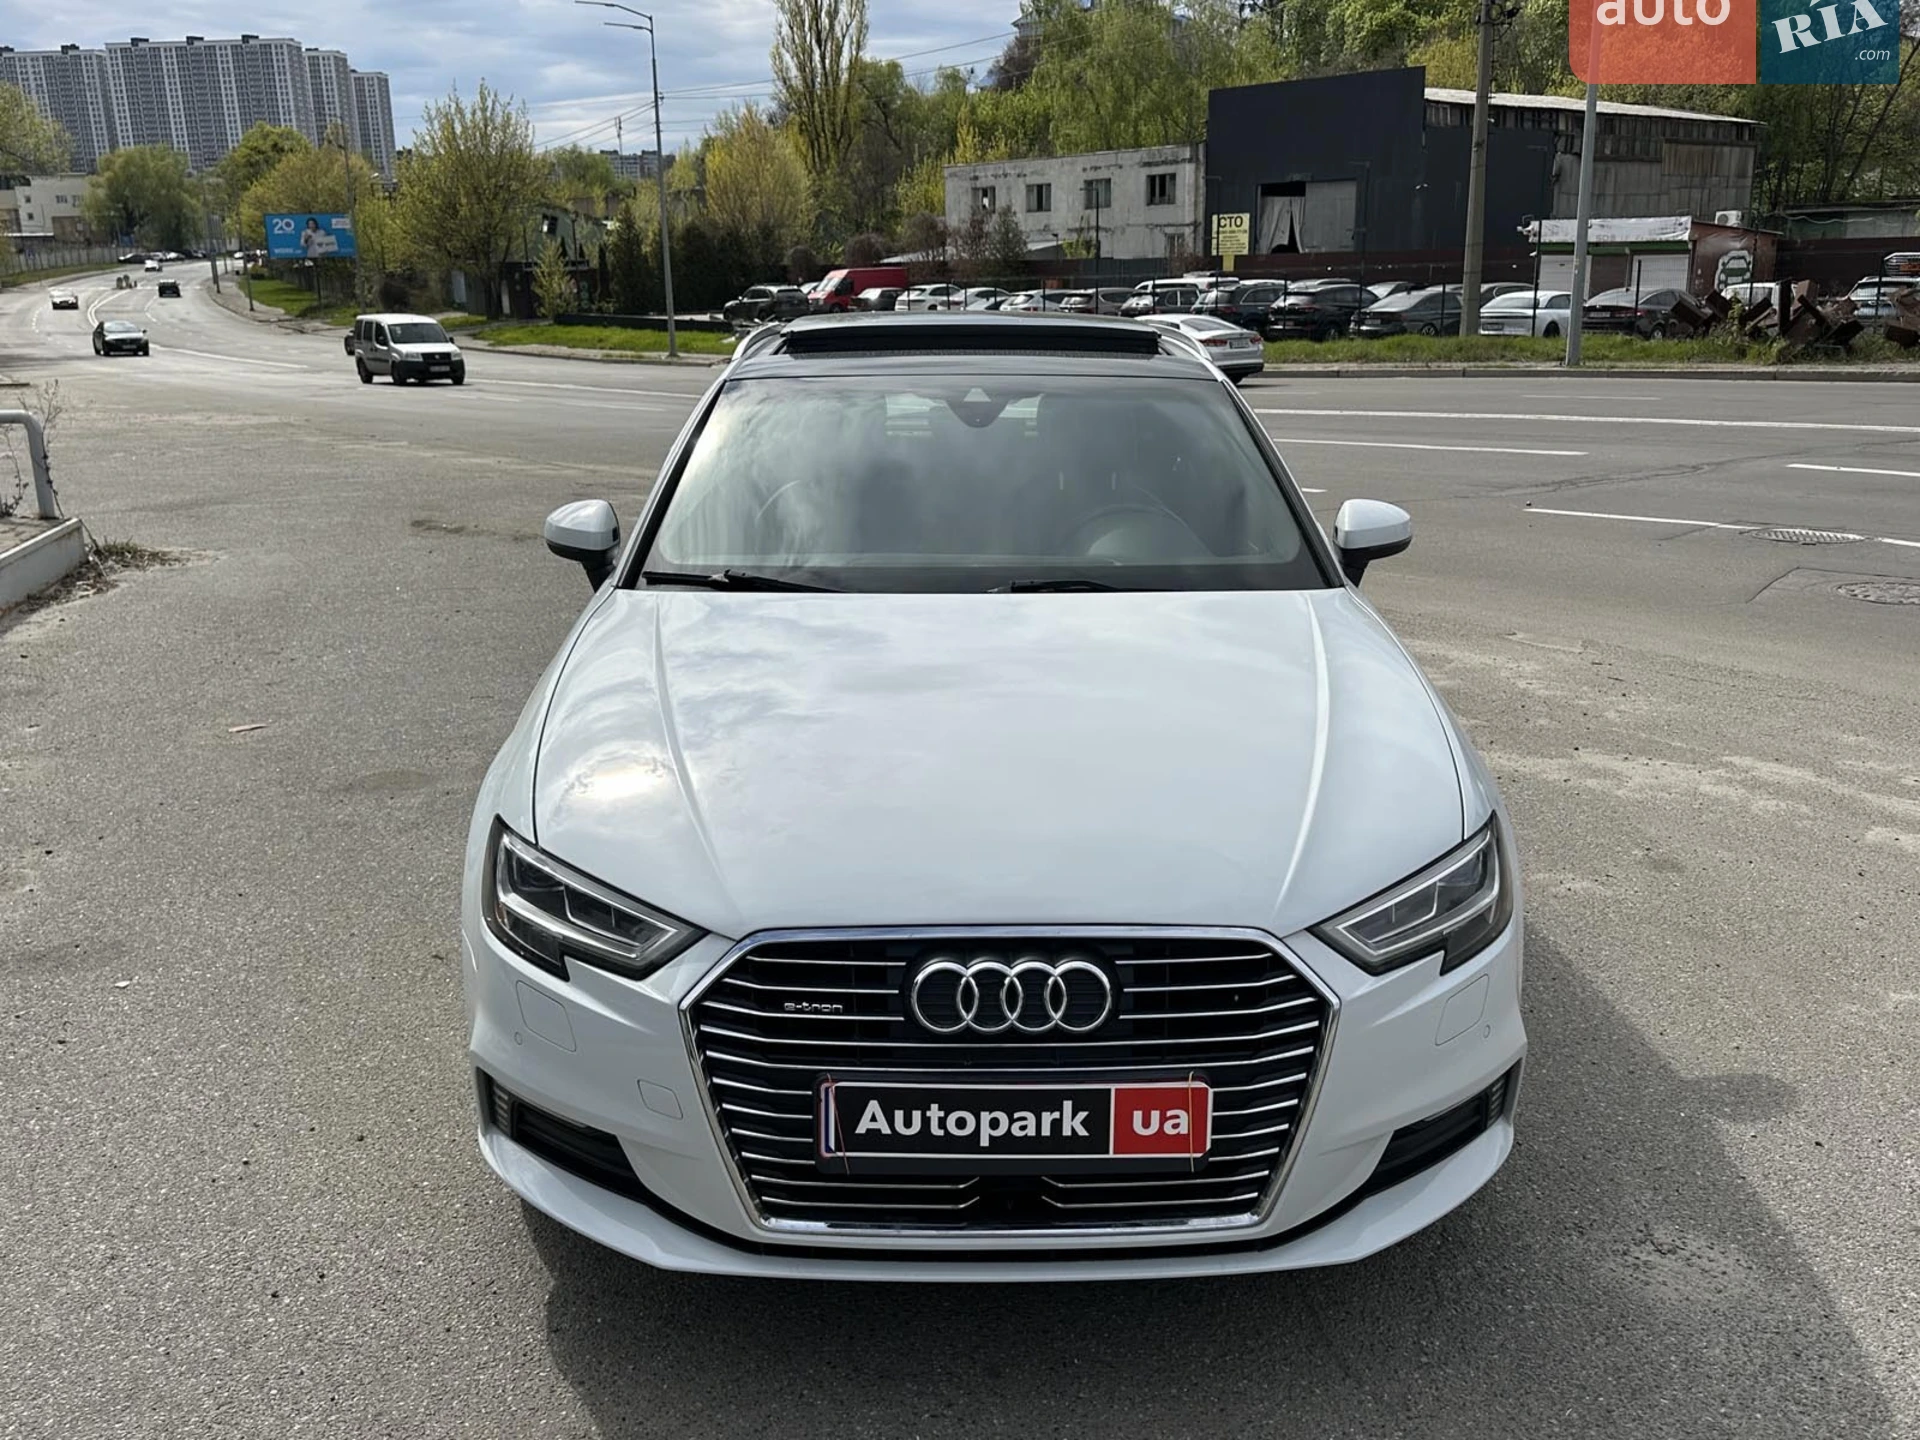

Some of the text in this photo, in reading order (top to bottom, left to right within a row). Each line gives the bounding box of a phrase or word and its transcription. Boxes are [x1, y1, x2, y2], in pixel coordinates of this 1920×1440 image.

[272, 218, 295, 235] 20
[784, 1002, 843, 1013] e-tron
[855, 1100, 1190, 1147] Autopark ua
